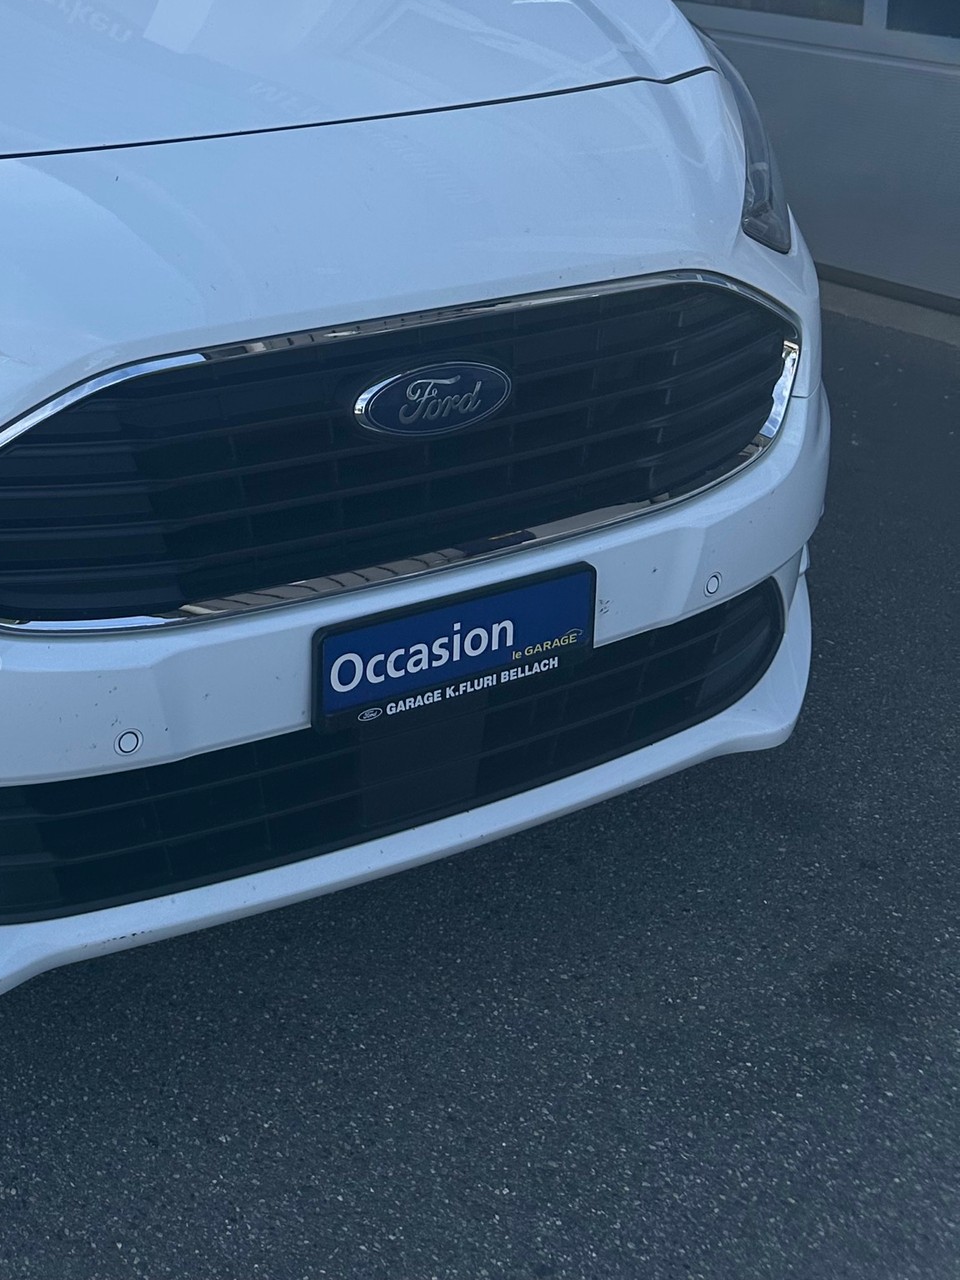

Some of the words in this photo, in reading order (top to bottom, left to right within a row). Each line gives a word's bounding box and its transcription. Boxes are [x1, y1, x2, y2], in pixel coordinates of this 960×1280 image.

[398, 374, 482, 425] Ford
[329, 619, 515, 693] Occasion
[512, 650, 522, 660] le
[524, 633, 578, 656] GARAGE
[386, 689, 442, 715] GARAGE
[445, 675, 497, 699] K.FLURI
[500, 656, 559, 683] BELLACH
